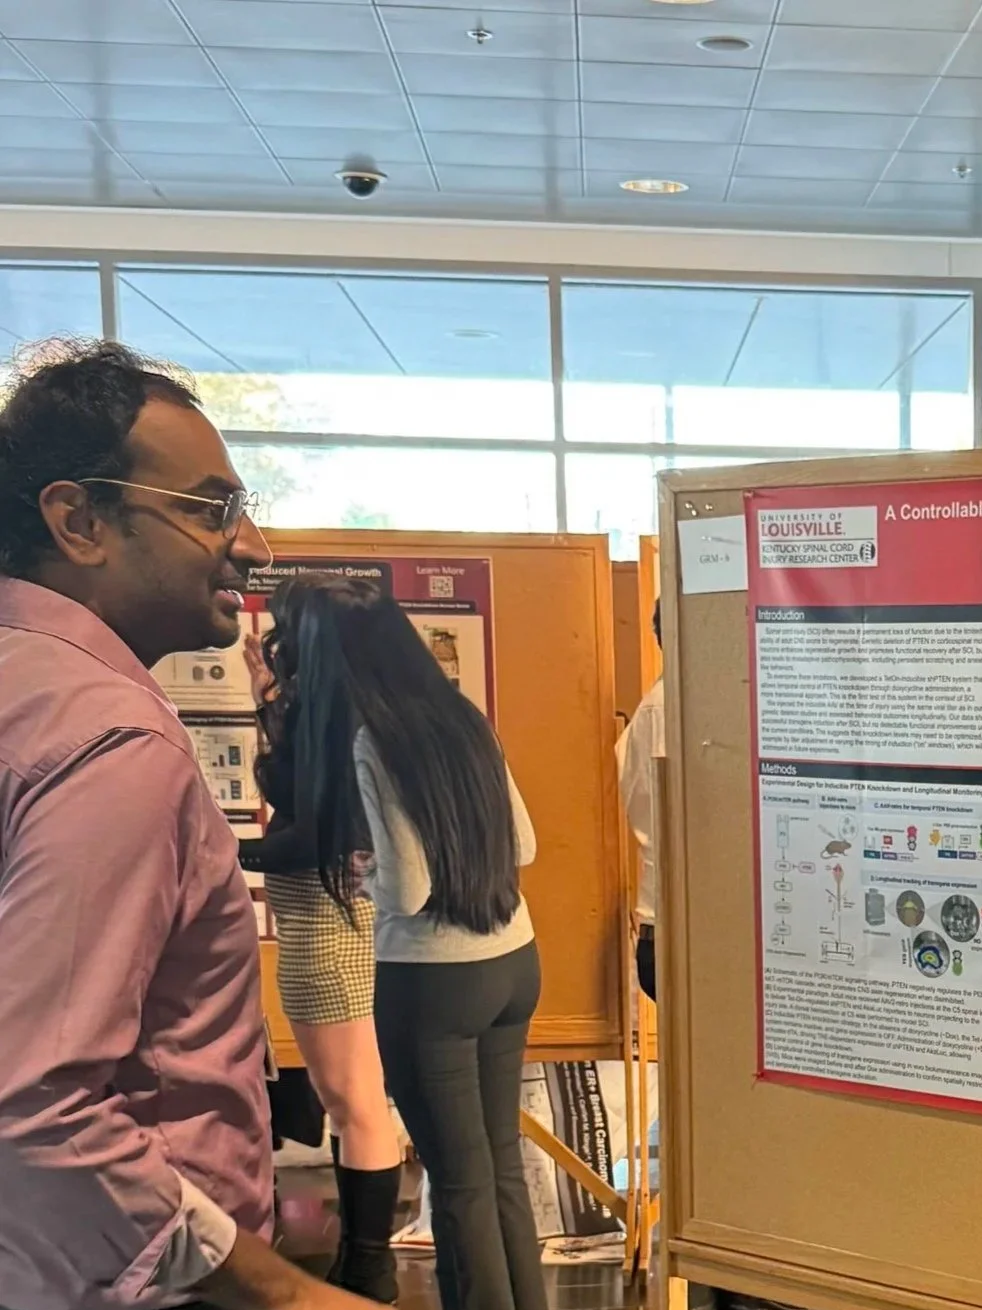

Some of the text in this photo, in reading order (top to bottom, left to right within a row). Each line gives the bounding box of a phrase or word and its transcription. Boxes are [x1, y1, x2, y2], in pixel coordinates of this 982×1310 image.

[761, 513, 822, 522] UNIVERSITY
[885, 504, 896, 520] A
[762, 543, 854, 553] KENTUCKY SPINAL CORD
[762, 554, 858, 563] INJURY RESEARCH CENTER
[345, 567, 382, 576] Growth
[417, 566, 465, 575] Learn More
[758, 610, 805, 620] Introduction
[761, 763, 797, 775] Methods
[797, 780, 815, 789] Design
[915, 787, 951, 795] Longitudinal
[585, 1069, 597, 1093] ER+
[589, 1093, 604, 1129] Breast
[595, 1129, 609, 1182] Carcinom
